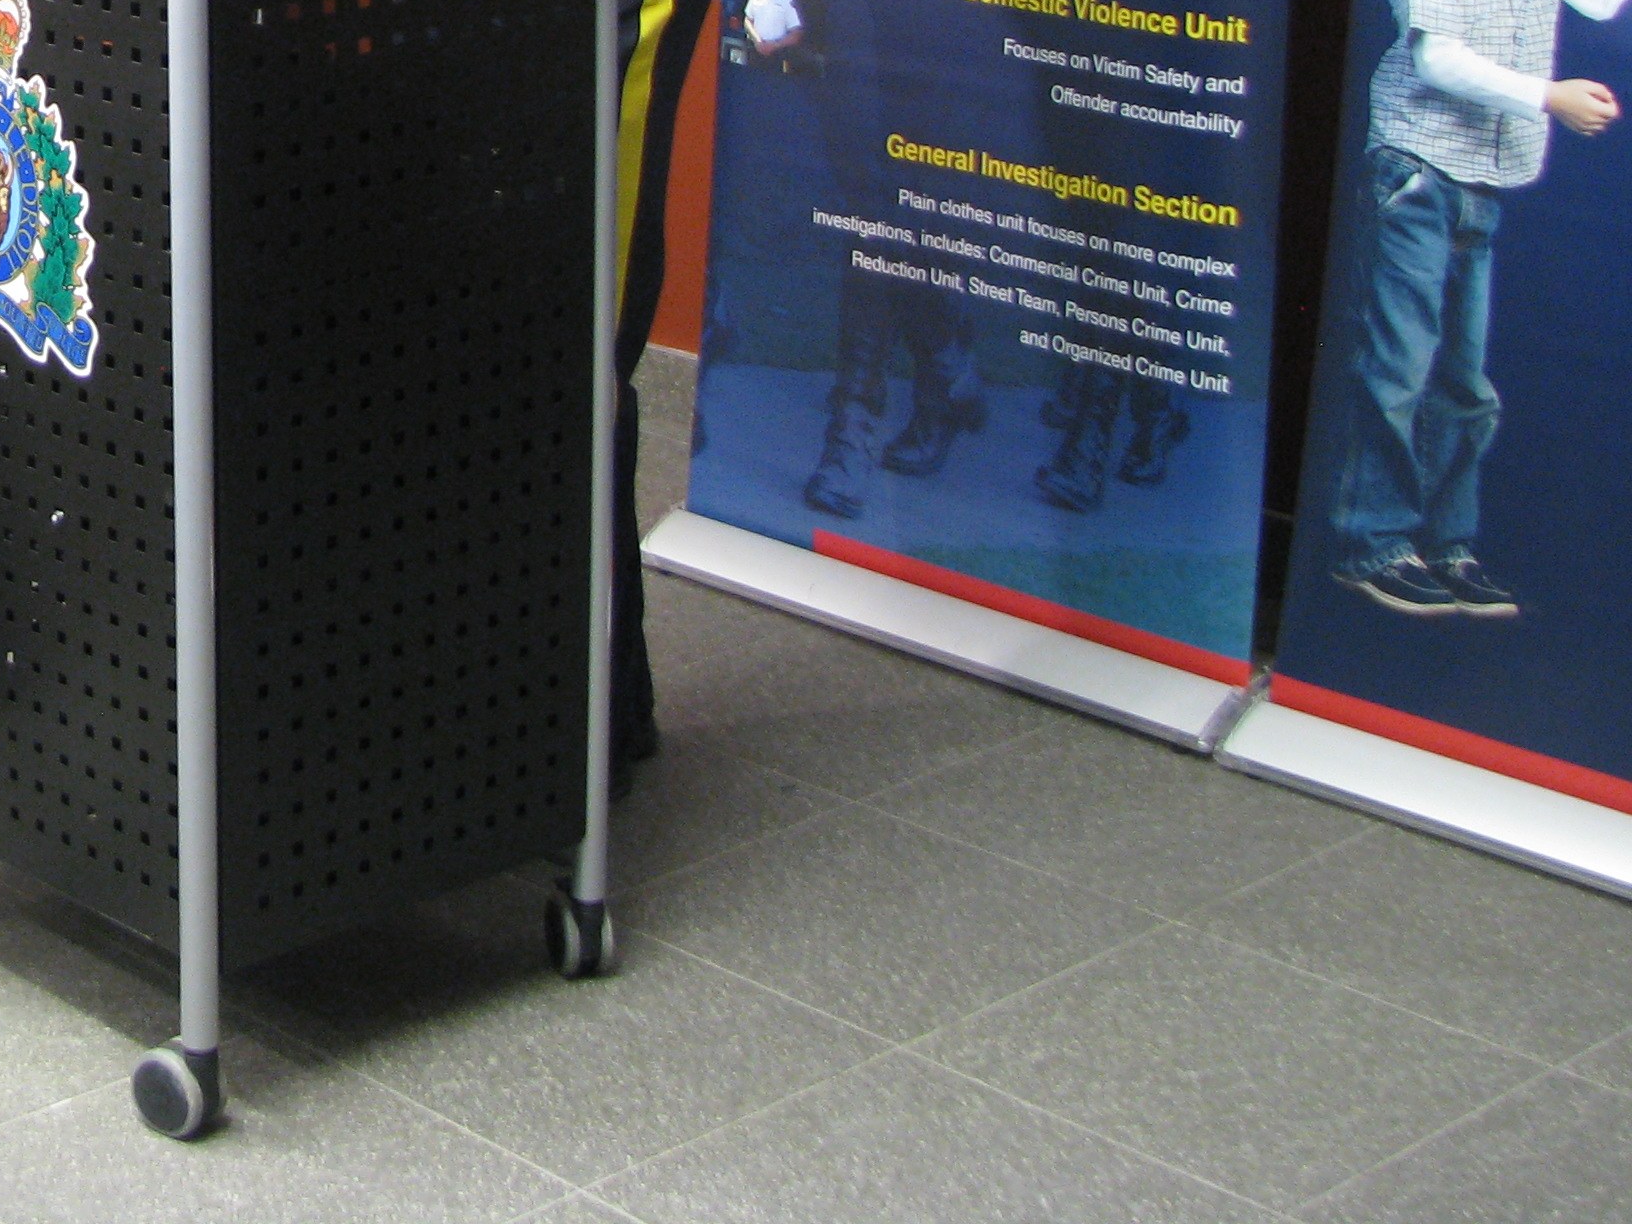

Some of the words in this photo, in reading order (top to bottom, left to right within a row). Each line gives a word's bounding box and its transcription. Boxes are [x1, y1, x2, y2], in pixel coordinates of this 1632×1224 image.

[1185, 11, 1249, 43] Unit
[1004, 38, 1067, 67] Focuses
[1070, 51, 1089, 70] on
[1093, 54, 1141, 79] Victim
[1145, 64, 1200, 94] Safety
[1205, 75, 1244, 95] and
[1051, 85, 1117, 114] Offender
[1120, 98, 1242, 138] accountability
[887, 133, 975, 173] General
[981, 152, 1128, 206] Investigation
[1134, 186, 1238, 226] Section
[813, 207, 917, 244] investigations,
[921, 229, 986, 259] includes:
[989, 244, 1078, 282] Commercial
[1082, 267, 1129, 295] Crime
[1133, 278, 1170, 308] Unit,
[1175, 288, 1233, 316] Crime
[898, 188, 936, 213] Plain
[940, 199, 993, 224] clothes
[997, 210, 1024, 233] unit
[1028, 215, 1086, 245] focuses
[1089, 232, 1109, 249] on
[1113, 237, 1154, 261] more
[1158, 244, 1236, 277] complex
[851, 251, 926, 282] Reduction
[930, 268, 964, 292] Unit,
[968, 276, 1013, 304] Street
[1016, 287, 1061, 317] Team,
[1065, 300, 1129, 334] Persons
[1132, 316, 1183, 343] Crime
[1187, 328, 1230, 357] Unit,
[1020, 328, 1049, 350] and
[1053, 336, 1131, 372] Organized
[1135, 356, 1186, 383] Crime
[1190, 369, 1230, 393] Unit
